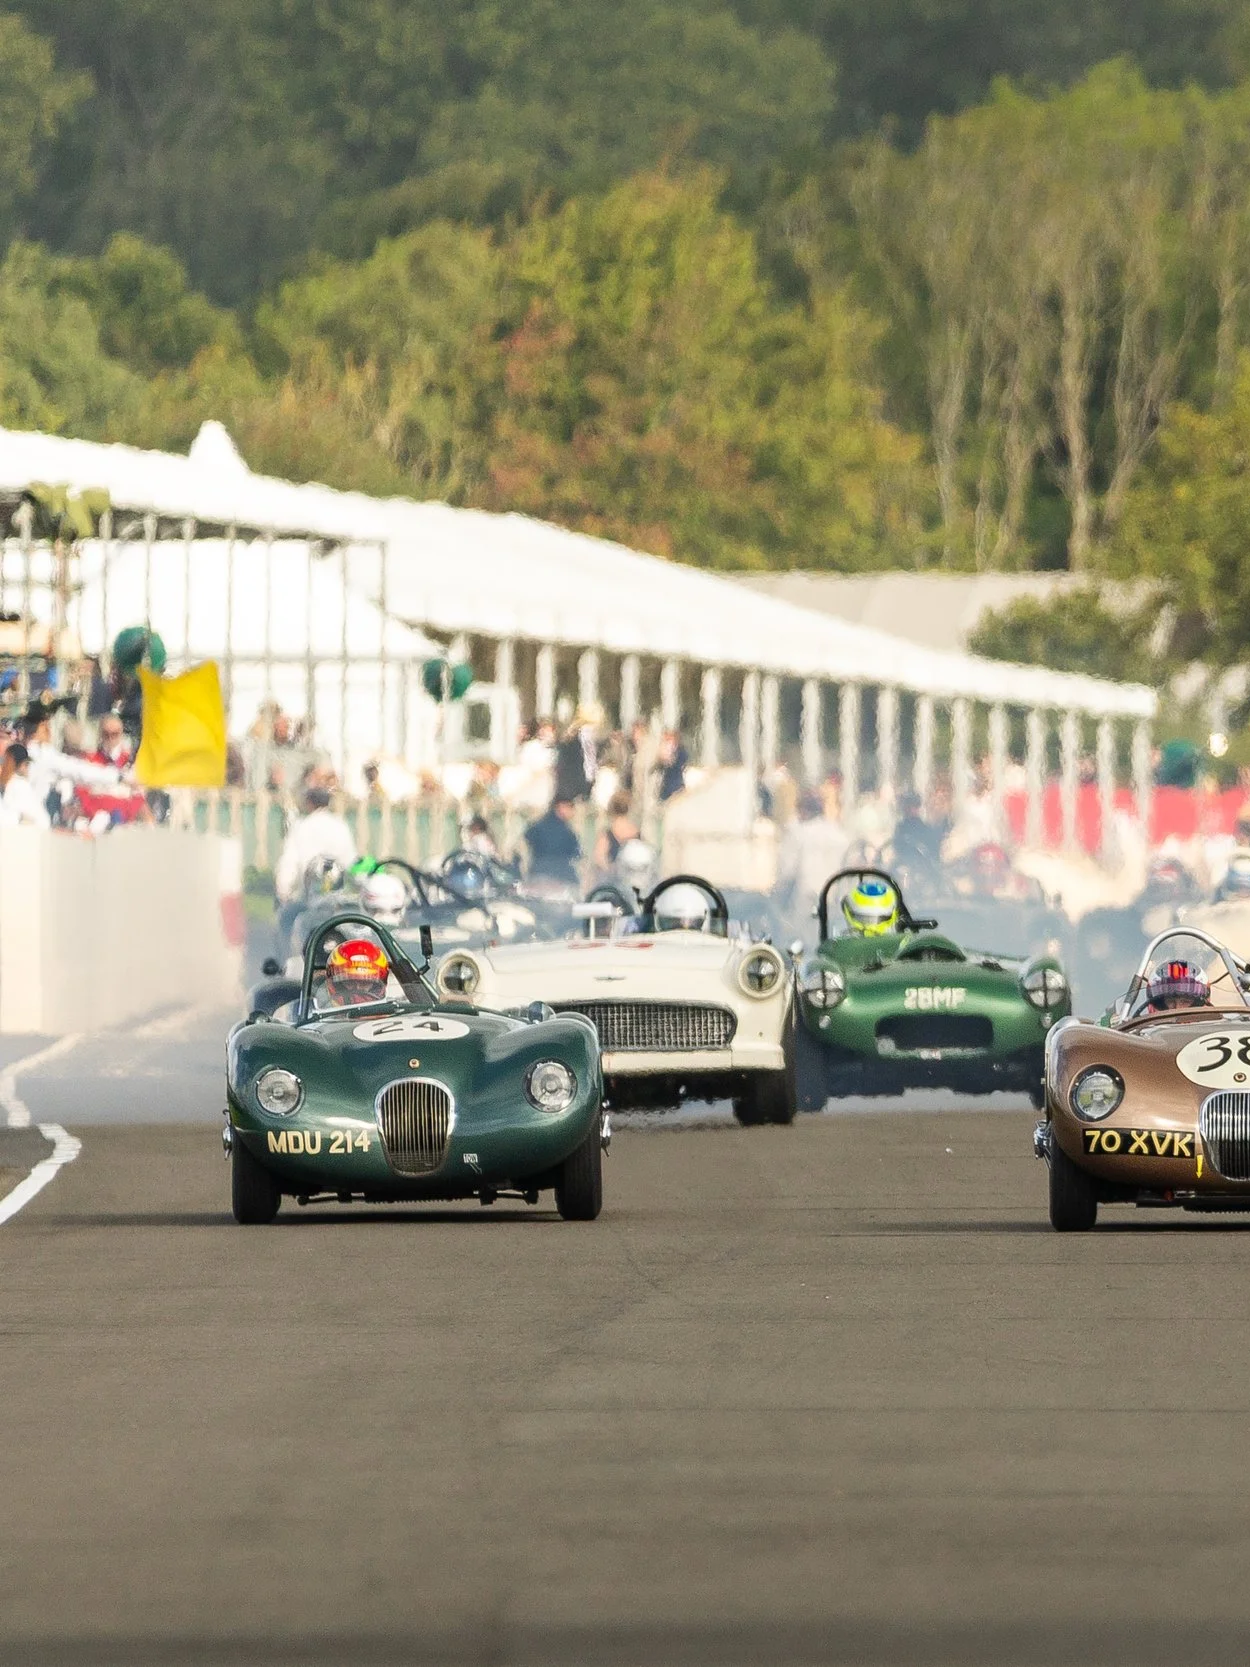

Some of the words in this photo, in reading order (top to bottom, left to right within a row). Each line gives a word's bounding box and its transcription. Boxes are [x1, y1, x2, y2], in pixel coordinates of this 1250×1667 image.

[372, 1020, 444, 1037] 24
[267, 1130, 322, 1155] MDU
[328, 1129, 371, 1154] 214
[1085, 1130, 1122, 1153] 70
[1127, 1130, 1192, 1157] XVK
